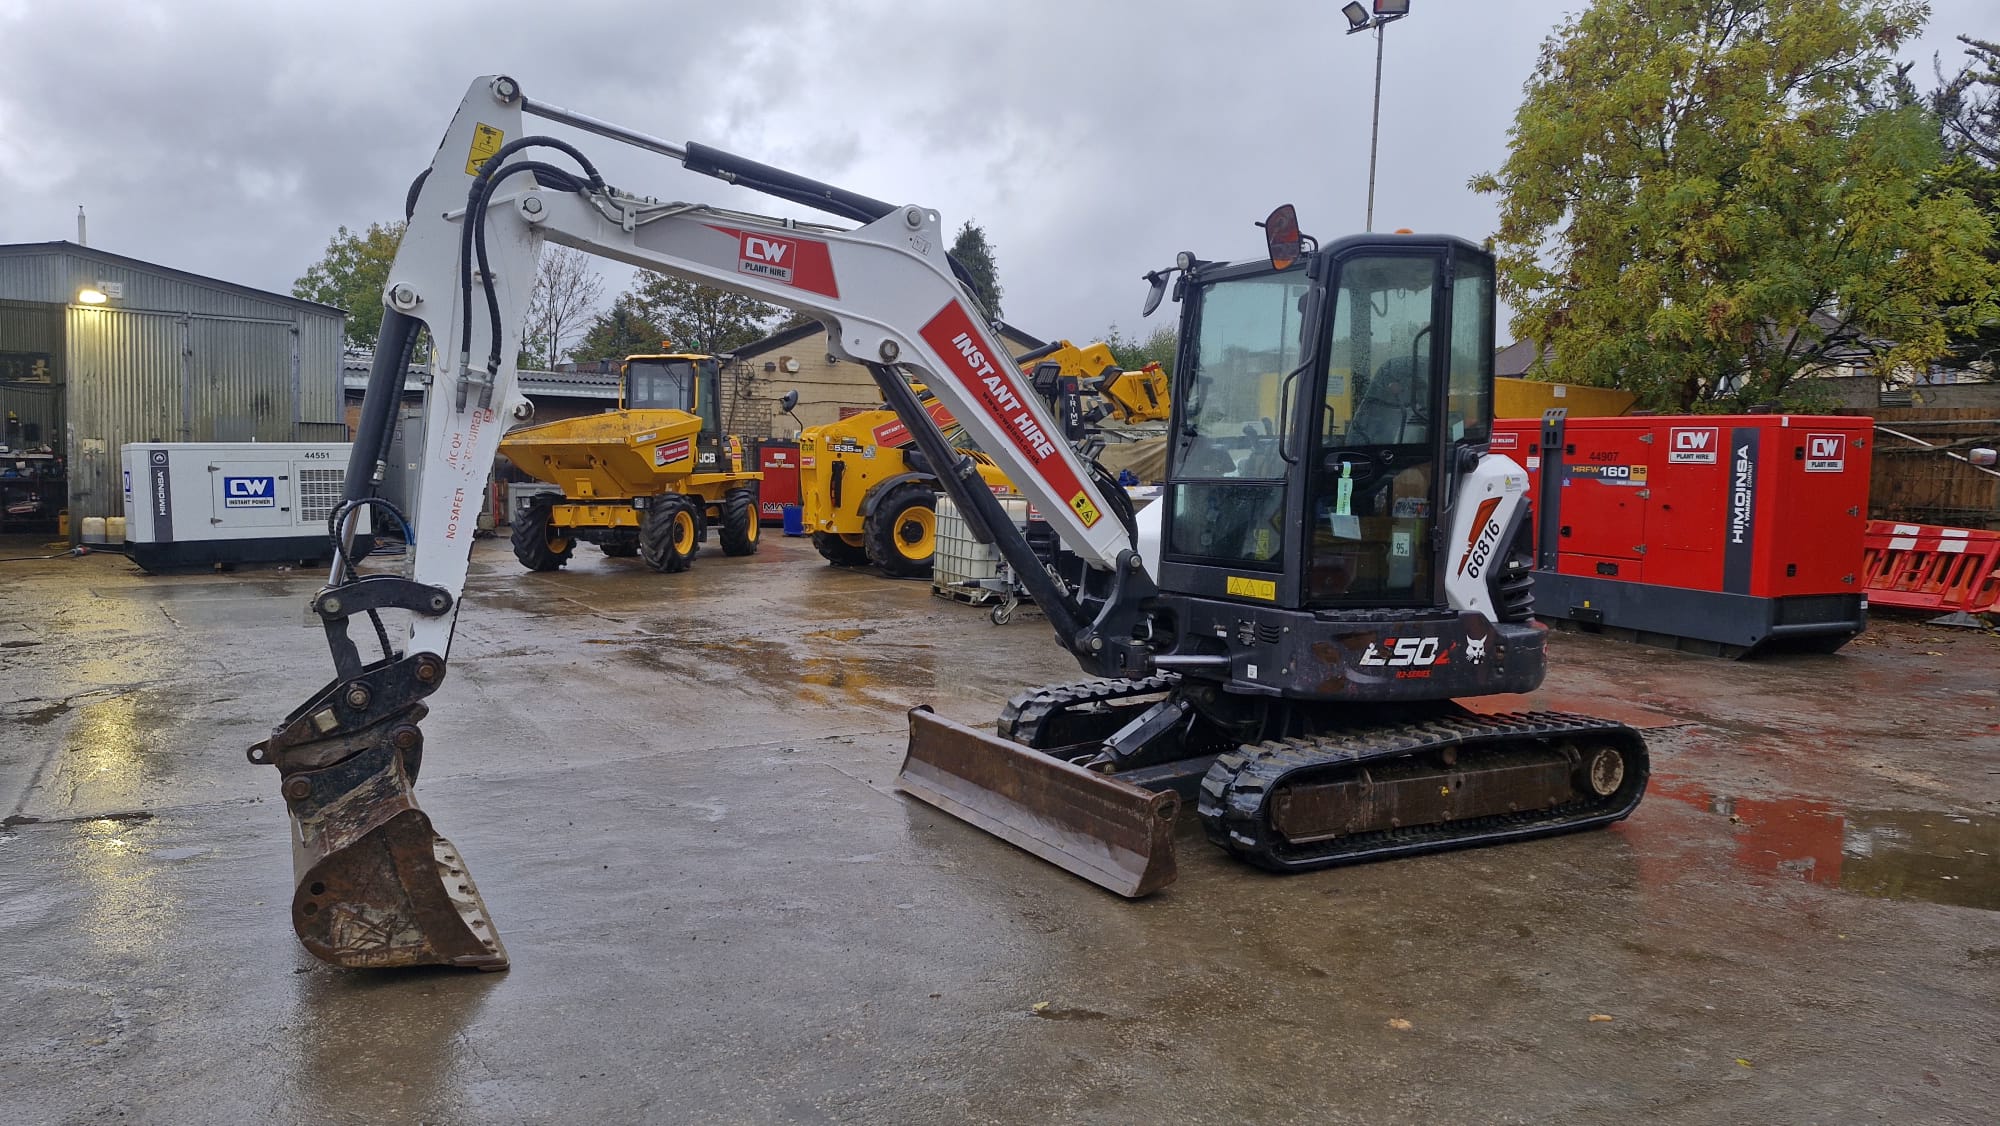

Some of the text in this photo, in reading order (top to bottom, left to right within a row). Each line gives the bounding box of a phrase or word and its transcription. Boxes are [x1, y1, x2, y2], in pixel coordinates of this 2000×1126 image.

[746, 237, 787, 263] CW
[745, 262, 786, 278] PLANT HIRE
[951, 332, 1056, 460] INSTANT HIRE
[1069, 393, 1078, 426] TRIME
[982, 392, 1040, 466] www.cwplant.co.uk
[1677, 432, 1710, 449] CW
[1812, 438, 1838, 456] CW
[699, 452, 716, 463] JCB
[1589, 451, 1619, 462] 44907
[1572, 465, 1599, 473] HRFW
[1600, 466, 1629, 477] 160
[158, 470, 167, 516] HIMOINSA
[230, 479, 267, 496] CW
[1732, 444, 1749, 544] HIMOINSA
[451, 488, 465, 522] SAFET
[446, 523, 457, 539] NO
[1467, 519, 1500, 579] 66816
